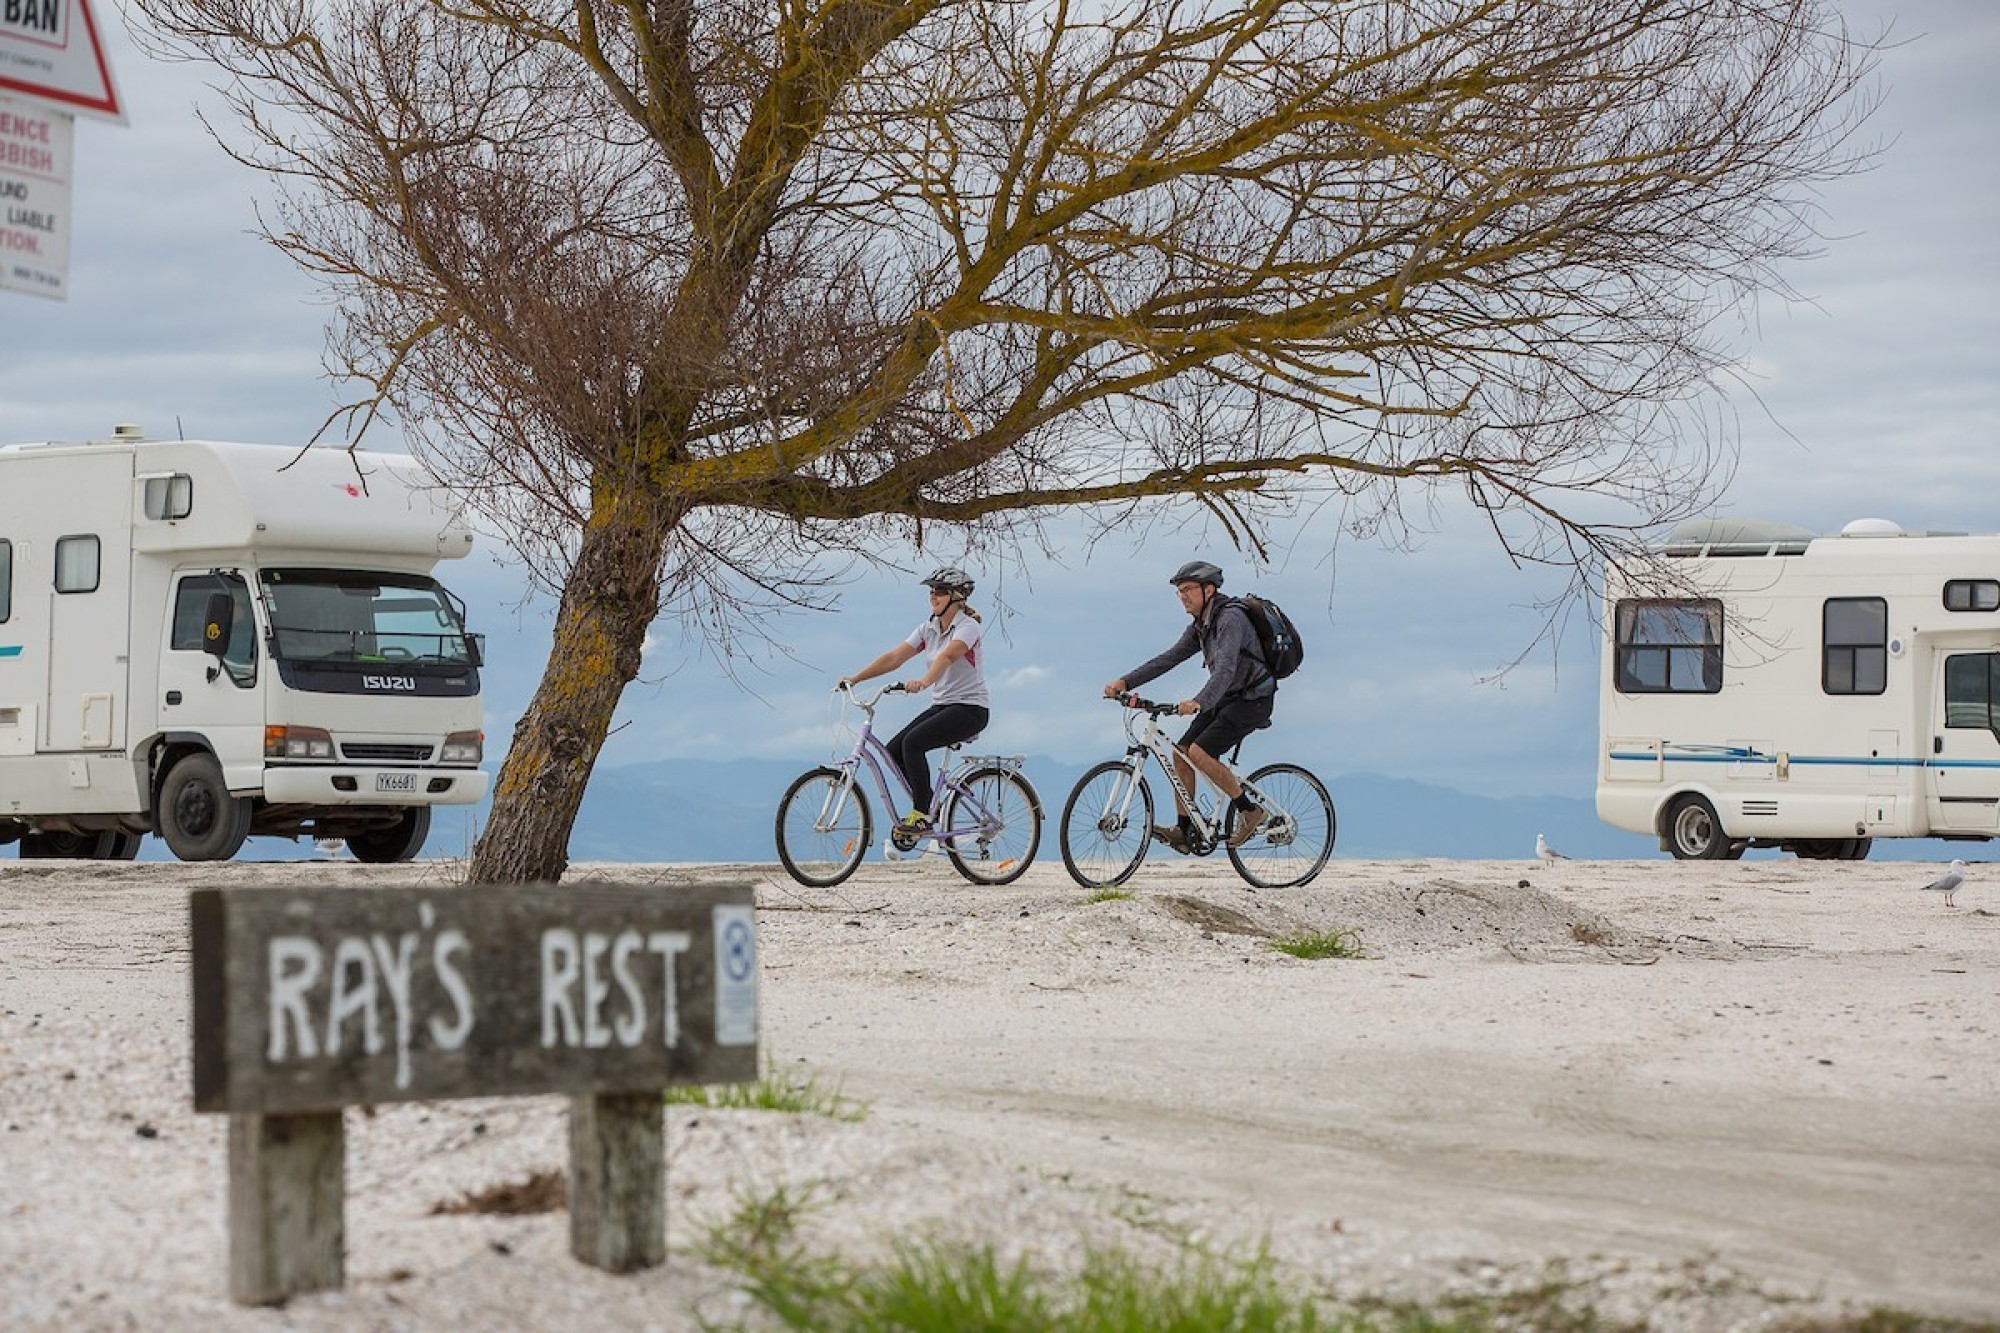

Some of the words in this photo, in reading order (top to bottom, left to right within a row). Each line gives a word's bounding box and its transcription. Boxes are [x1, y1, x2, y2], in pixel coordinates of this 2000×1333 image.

[4, 0, 58, 34] BAN
[8, 205, 55, 233] LIABLE
[362, 675, 416, 691] ISUZU
[266, 901, 475, 1090] RAY'S
[540, 926, 692, 1050] REST
